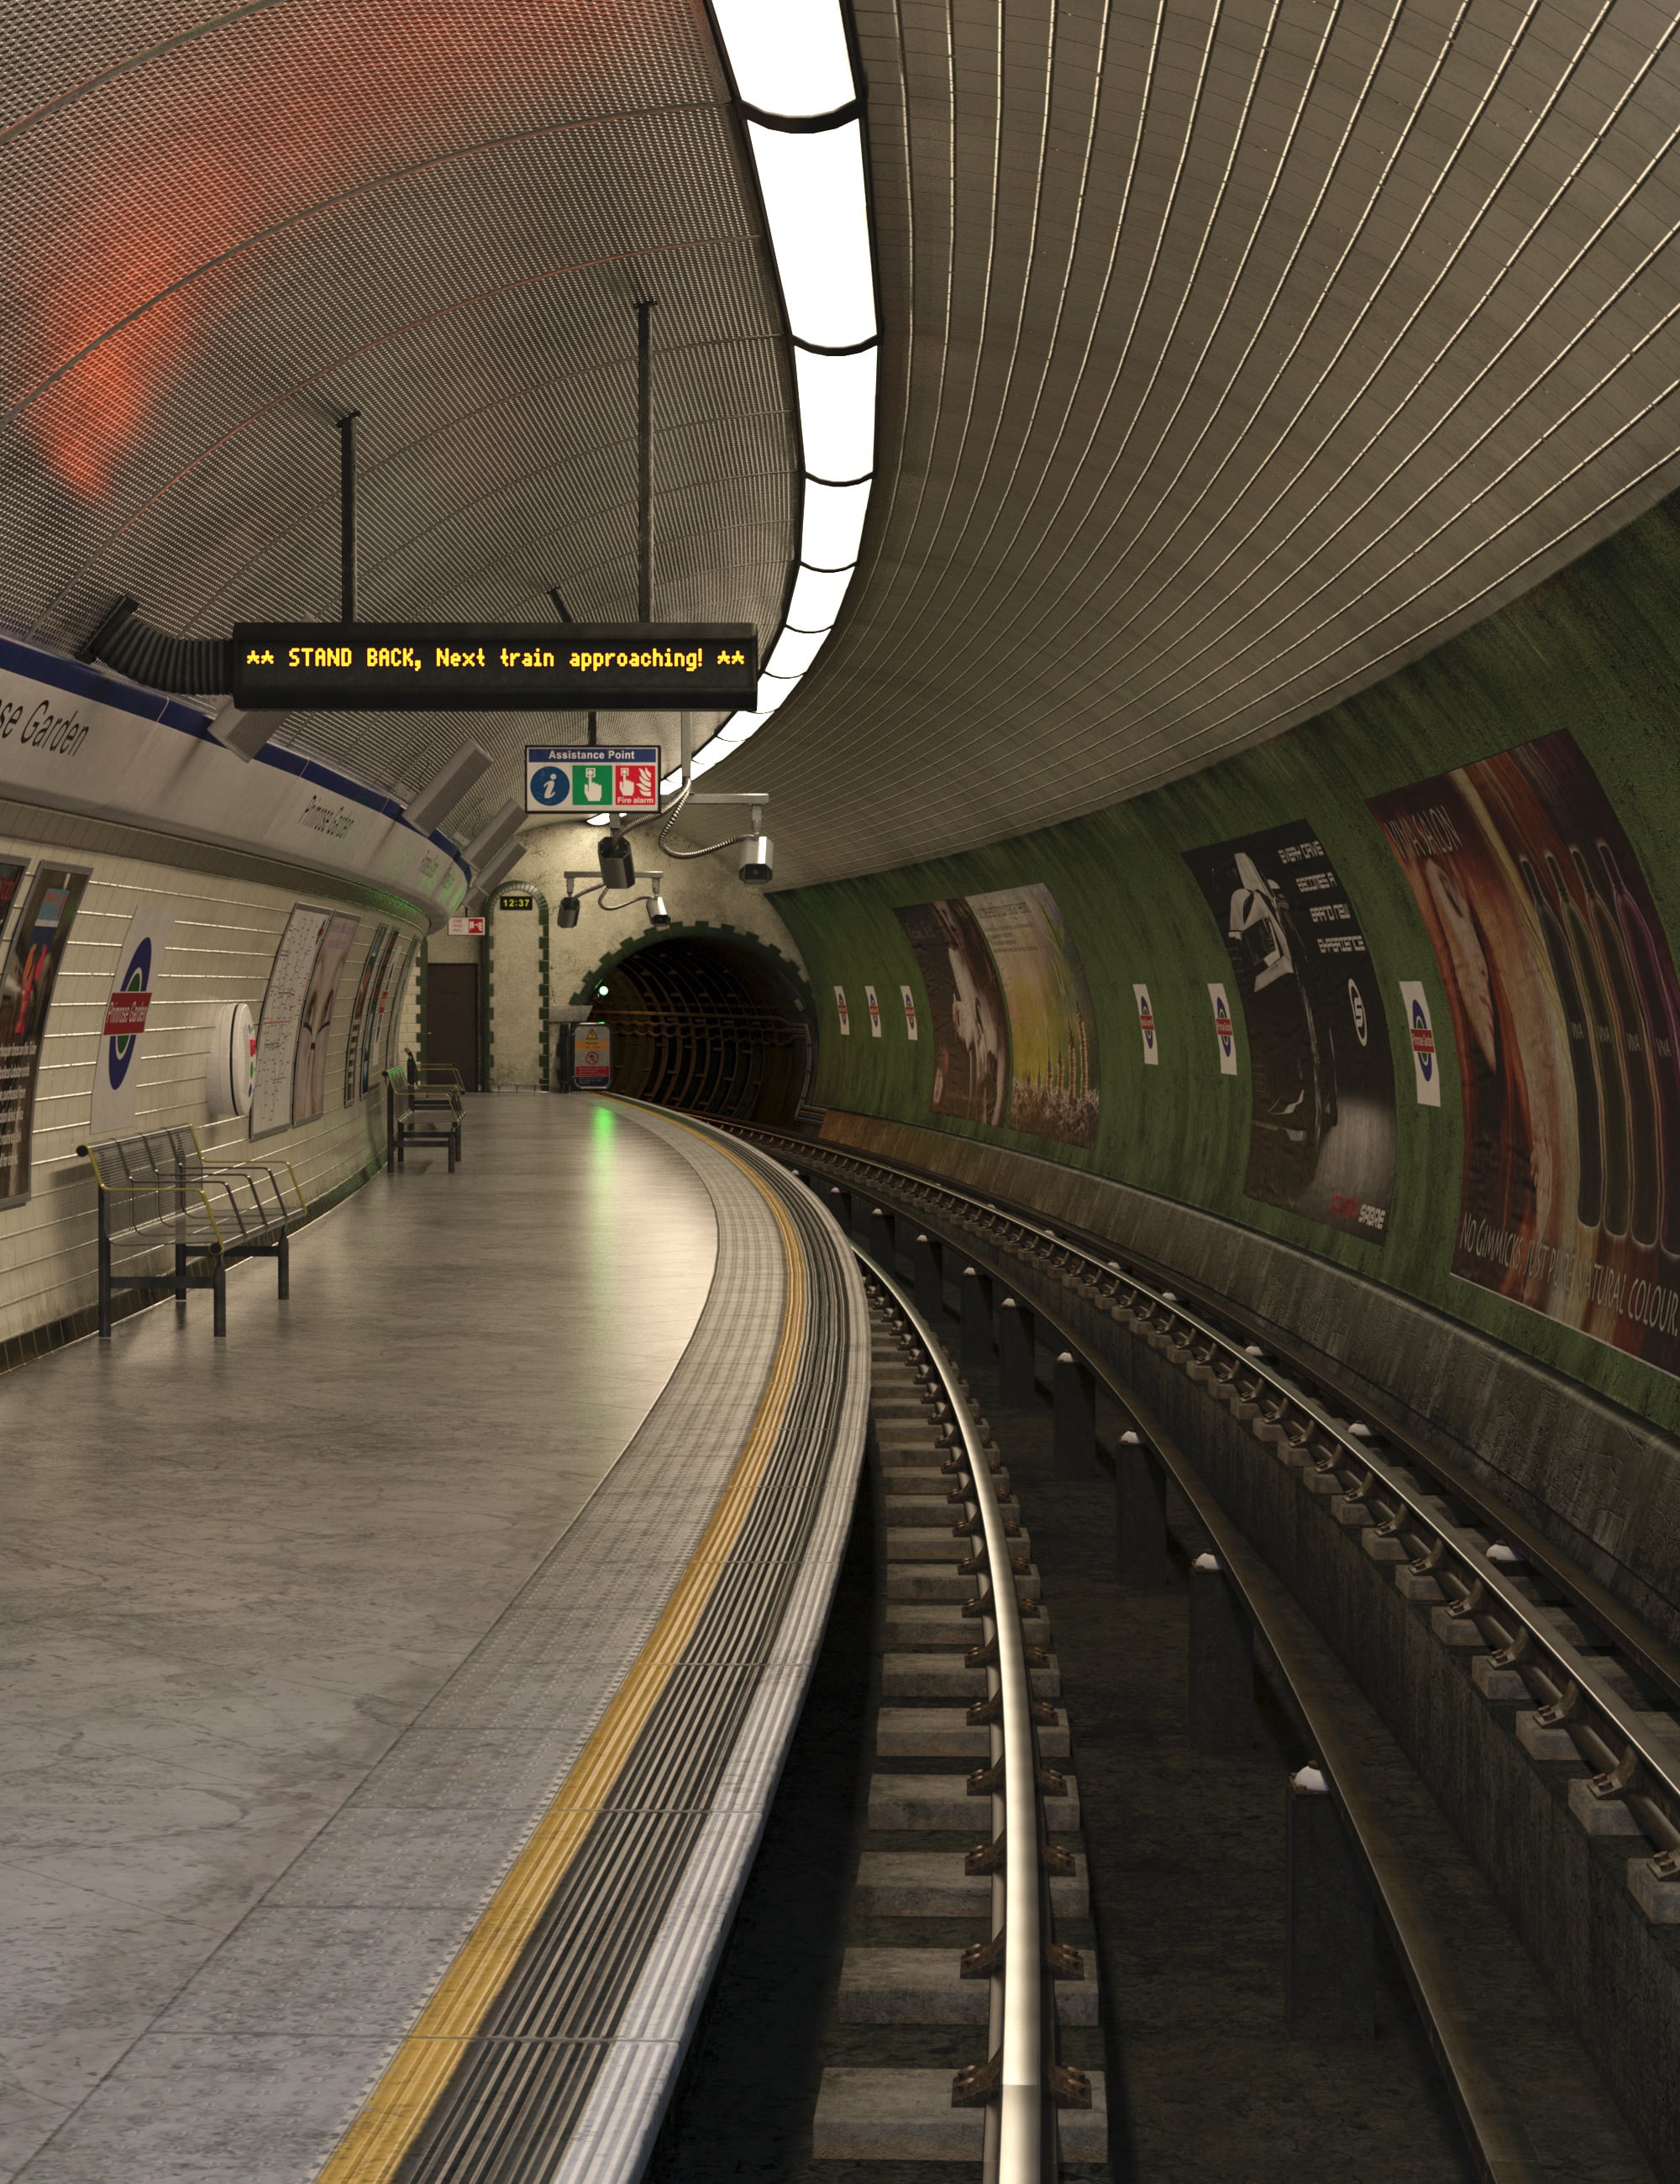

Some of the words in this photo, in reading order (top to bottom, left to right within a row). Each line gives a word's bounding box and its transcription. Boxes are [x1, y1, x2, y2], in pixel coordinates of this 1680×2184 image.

[288, 647, 353, 667] STAND
[366, 647, 422, 672] BACK,
[436, 647, 486, 667] Next
[500, 647, 554, 668] train
[569, 648, 703, 672] approaching!
[20, 699, 90, 757] Garden
[549, 750, 605, 759] Assistance
[608, 750, 635, 759] Point
[1383, 816, 1426, 861] VIVA
[1411, 805, 1463, 856] SALON
[1278, 846, 1303, 864] EVERY
[1299, 840, 1325, 859] DRIVE
[1295, 873, 1331, 892] BECOMES
[1327, 872, 1338, 888] A
[503, 899, 530, 907] 12:37
[1309, 905, 1335, 923] BRAND
[1332, 903, 1351, 921] NEW
[1317, 935, 1366, 954] EXPERIENCE
[107, 1001, 130, 1023] Primrose
[129, 1000, 148, 1022] Garden
[1570, 1021, 1584, 1040] VIVA
[1598, 1025, 1611, 1042] VIVA
[1626, 1032, 1641, 1053] VIVA
[1656, 1037, 1672, 1058] VIVA
[1357, 1204, 1386, 1230] SABRE
[1459, 1211, 1477, 1253] NO
[1476, 1218, 1524, 1277] GIMMICKS,
[1523, 1239, 1550, 1281] JUST
[1547, 1247, 1577, 1294] PURE
[1578, 1259, 1627, 1315] NATURAL
[1628, 1278, 1678, 1337] COLOUR.
